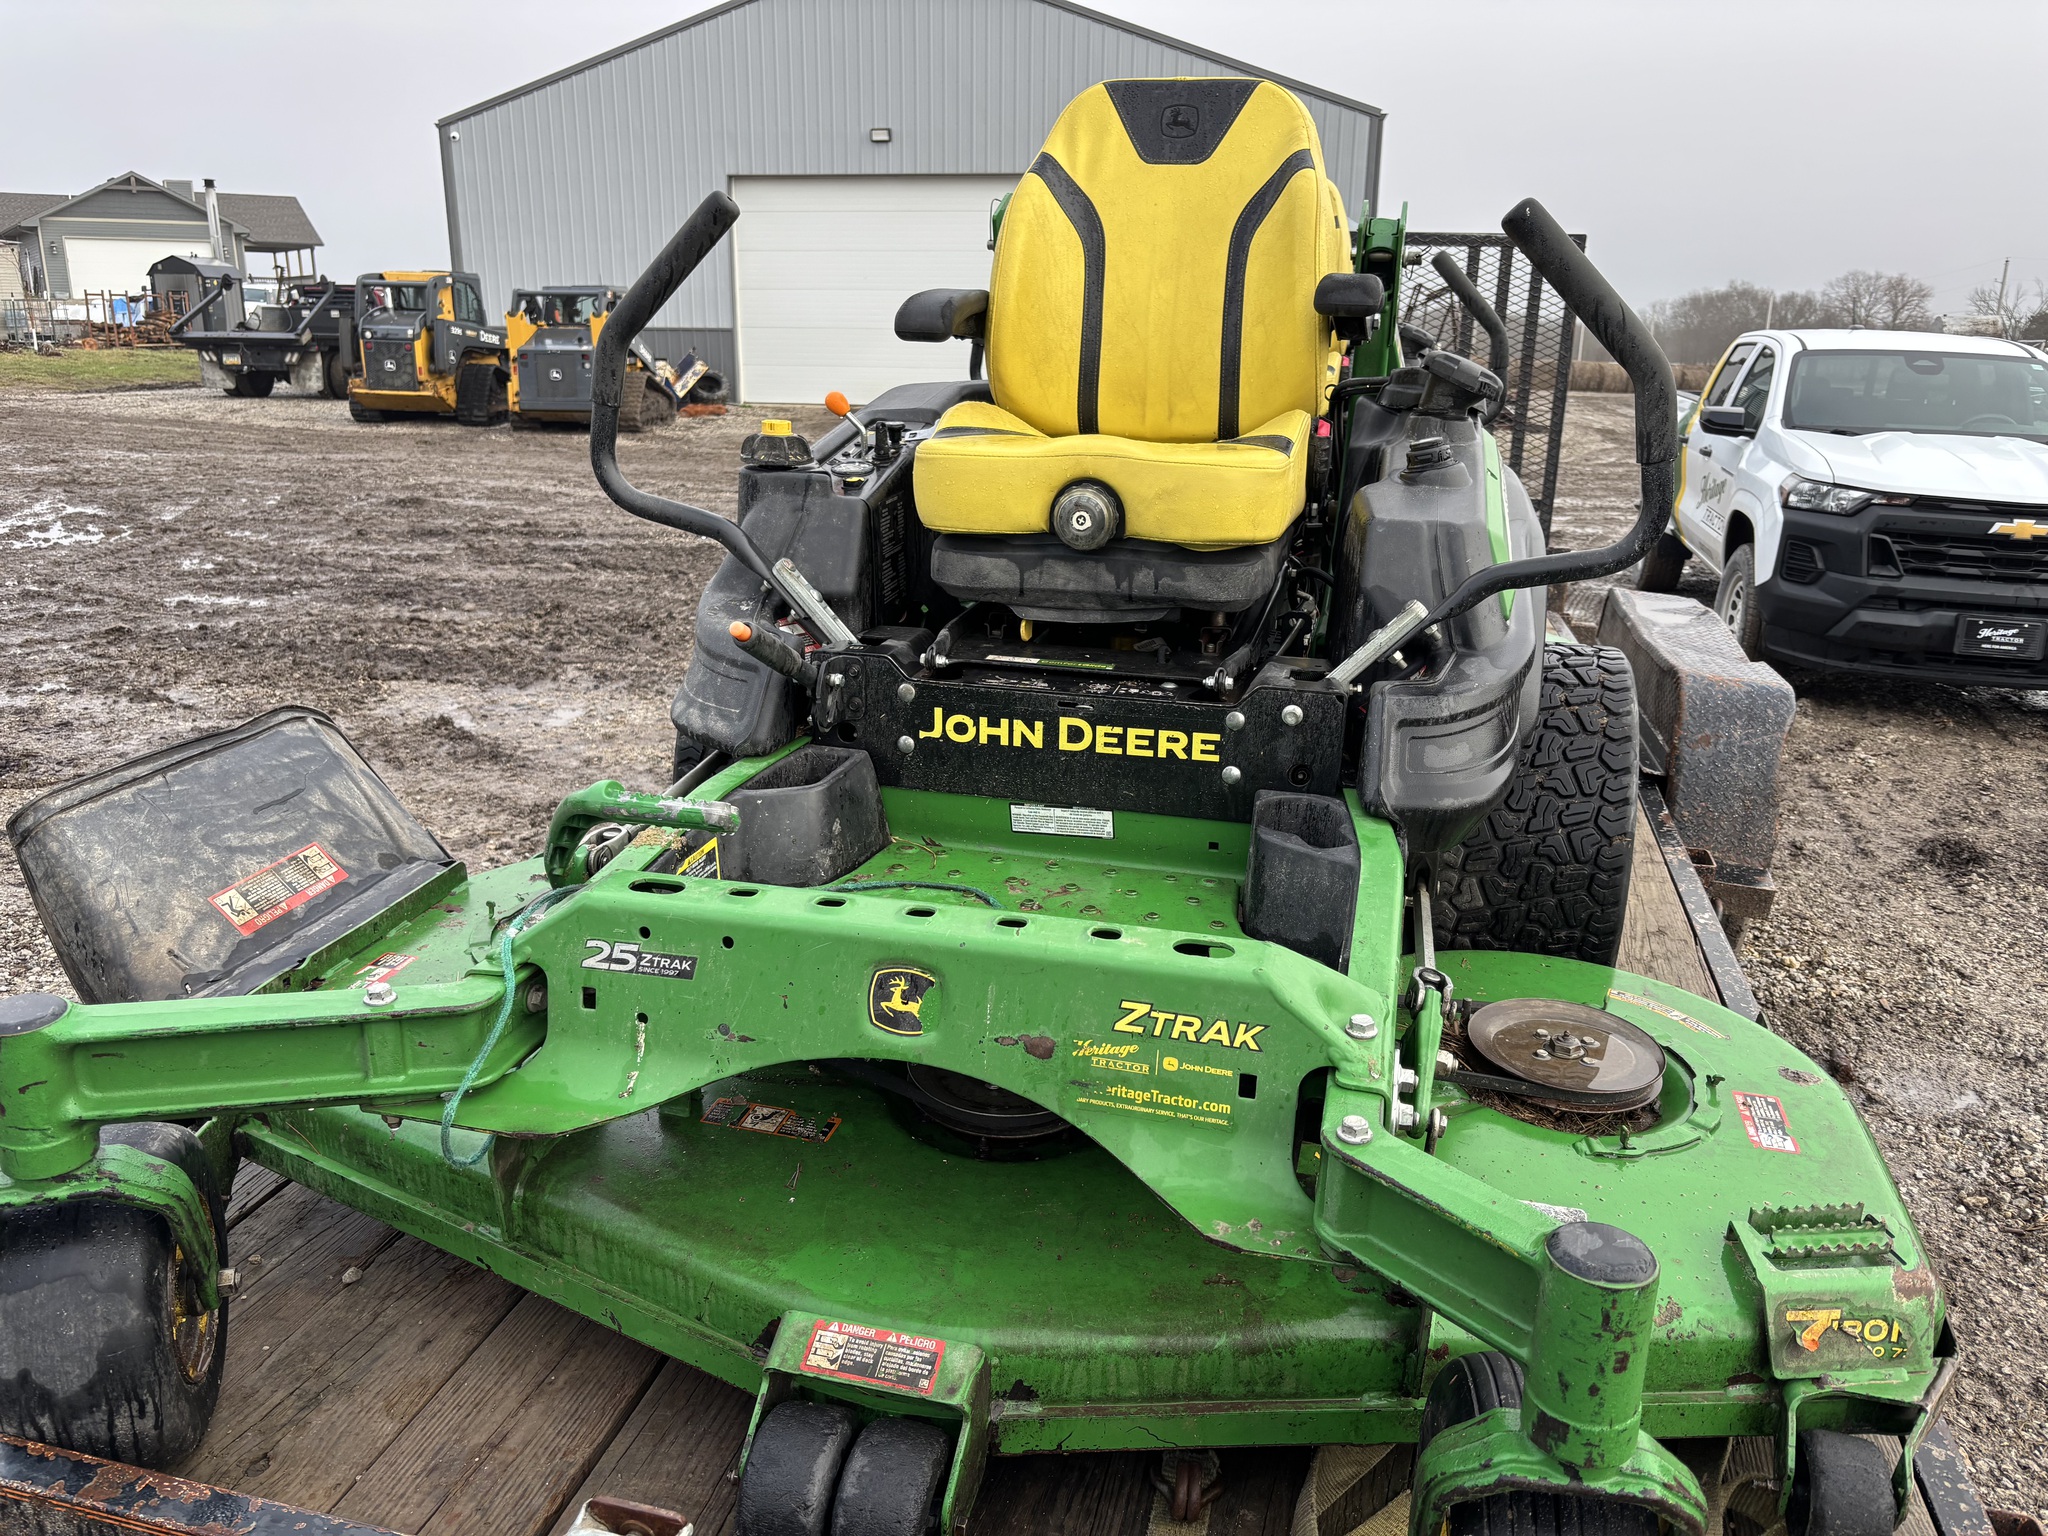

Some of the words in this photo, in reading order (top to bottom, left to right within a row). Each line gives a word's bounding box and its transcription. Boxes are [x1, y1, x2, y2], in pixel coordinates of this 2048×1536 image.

[480, 330, 500, 345] DEERE
[1696, 472, 1727, 509] Heritage
[1976, 628, 2019, 638] Heritage
[919, 707, 1044, 749] JOHN
[1059, 716, 1221, 762] DEERE
[305, 880, 331, 896] DANGER
[254, 905, 283, 926] PELIGRO
[581, 940, 638, 971] 25
[640, 954, 692, 970] ZTRAK
[1112, 999, 1268, 1052] ZTRAK
[1093, 1058, 1149, 1073] TRACTOR
[1179, 1062, 1204, 1072] JOHN
[1205, 1065, 1233, 1077] DEERE
[1090, 1099, 1115, 1108] PRODUCTS,
[1116, 1103, 1154, 1113] EXTRAORDINARY
[1155, 1109, 1175, 1117] SERVICE,
[1177, 1112, 1193, 1120] THAT'S
[1205, 1117, 1229, 1126] HERITAGE.
[842, 1323, 876, 1338] DANGER
[899, 1334, 936, 1350] PELIGRO
